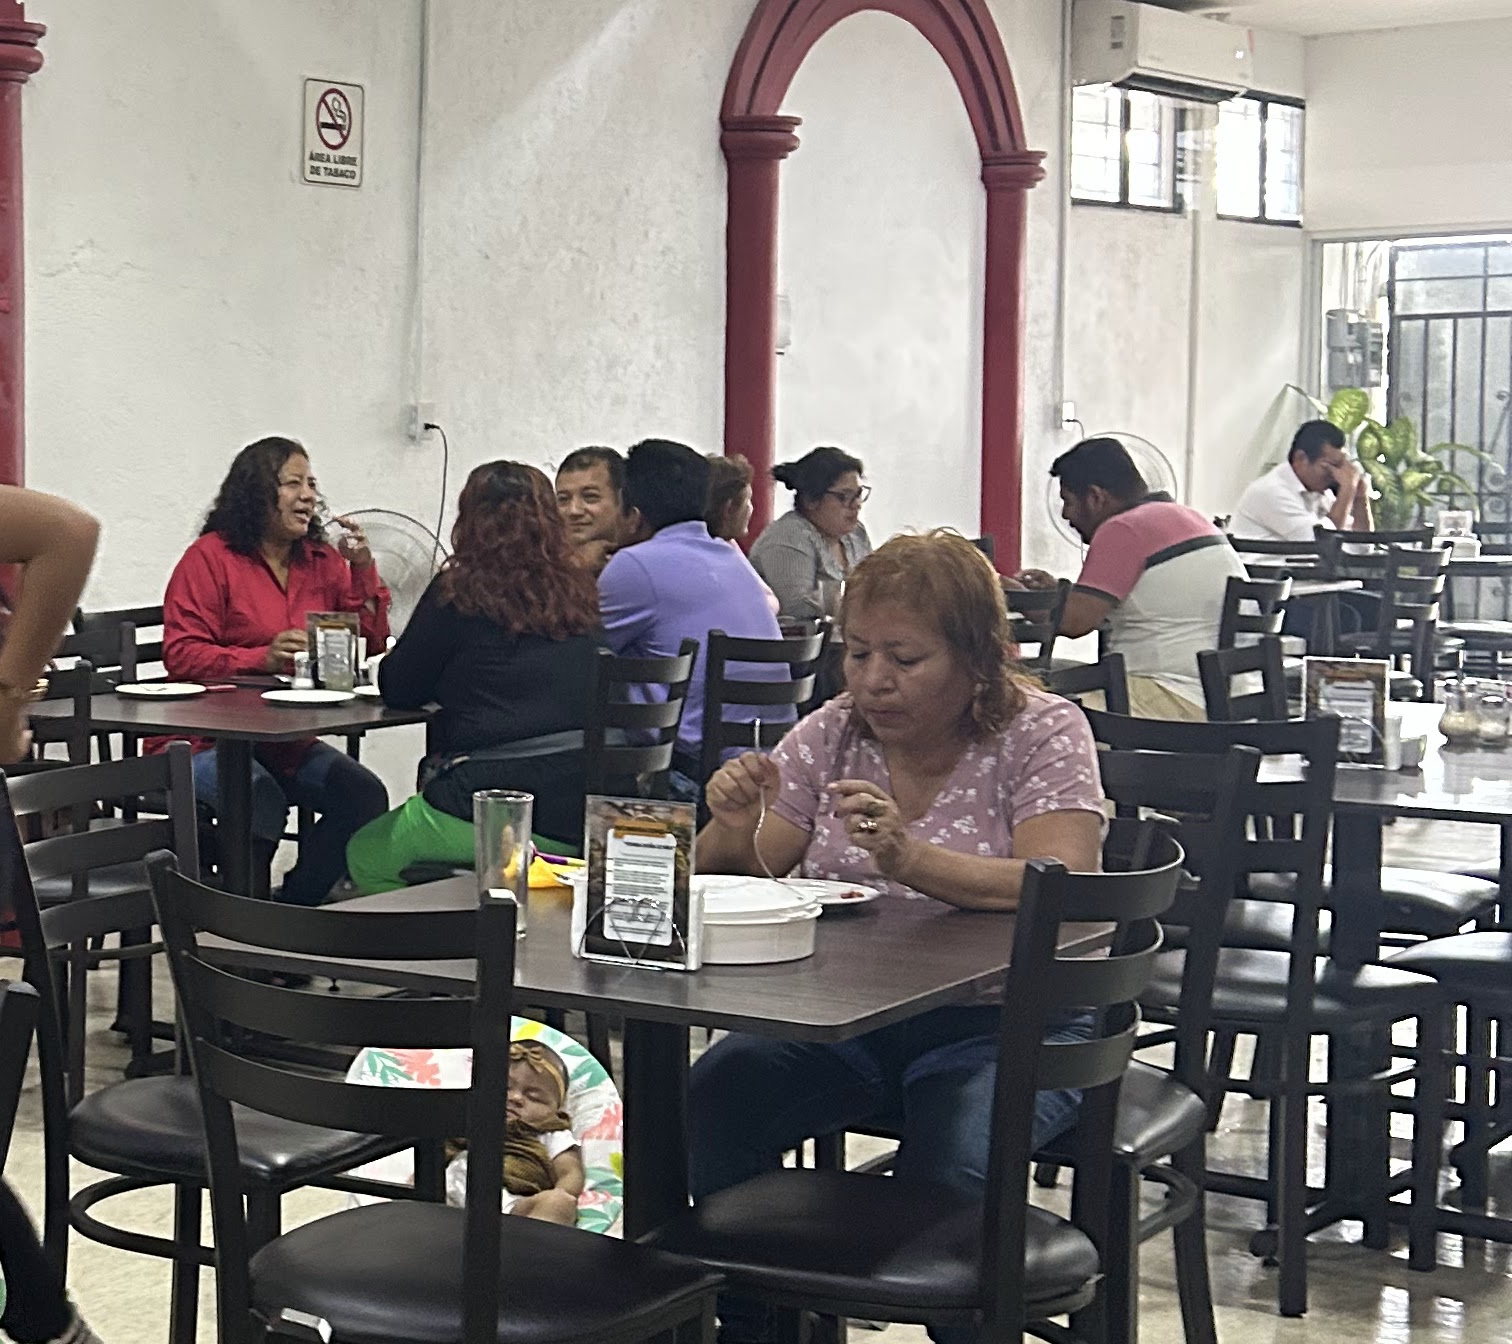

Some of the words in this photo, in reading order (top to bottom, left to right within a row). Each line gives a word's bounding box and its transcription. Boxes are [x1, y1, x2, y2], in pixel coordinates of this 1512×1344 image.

[333, 155, 357, 166] LIBRE
[309, 165, 321, 176] DE
[322, 166, 356, 179] TABACO
